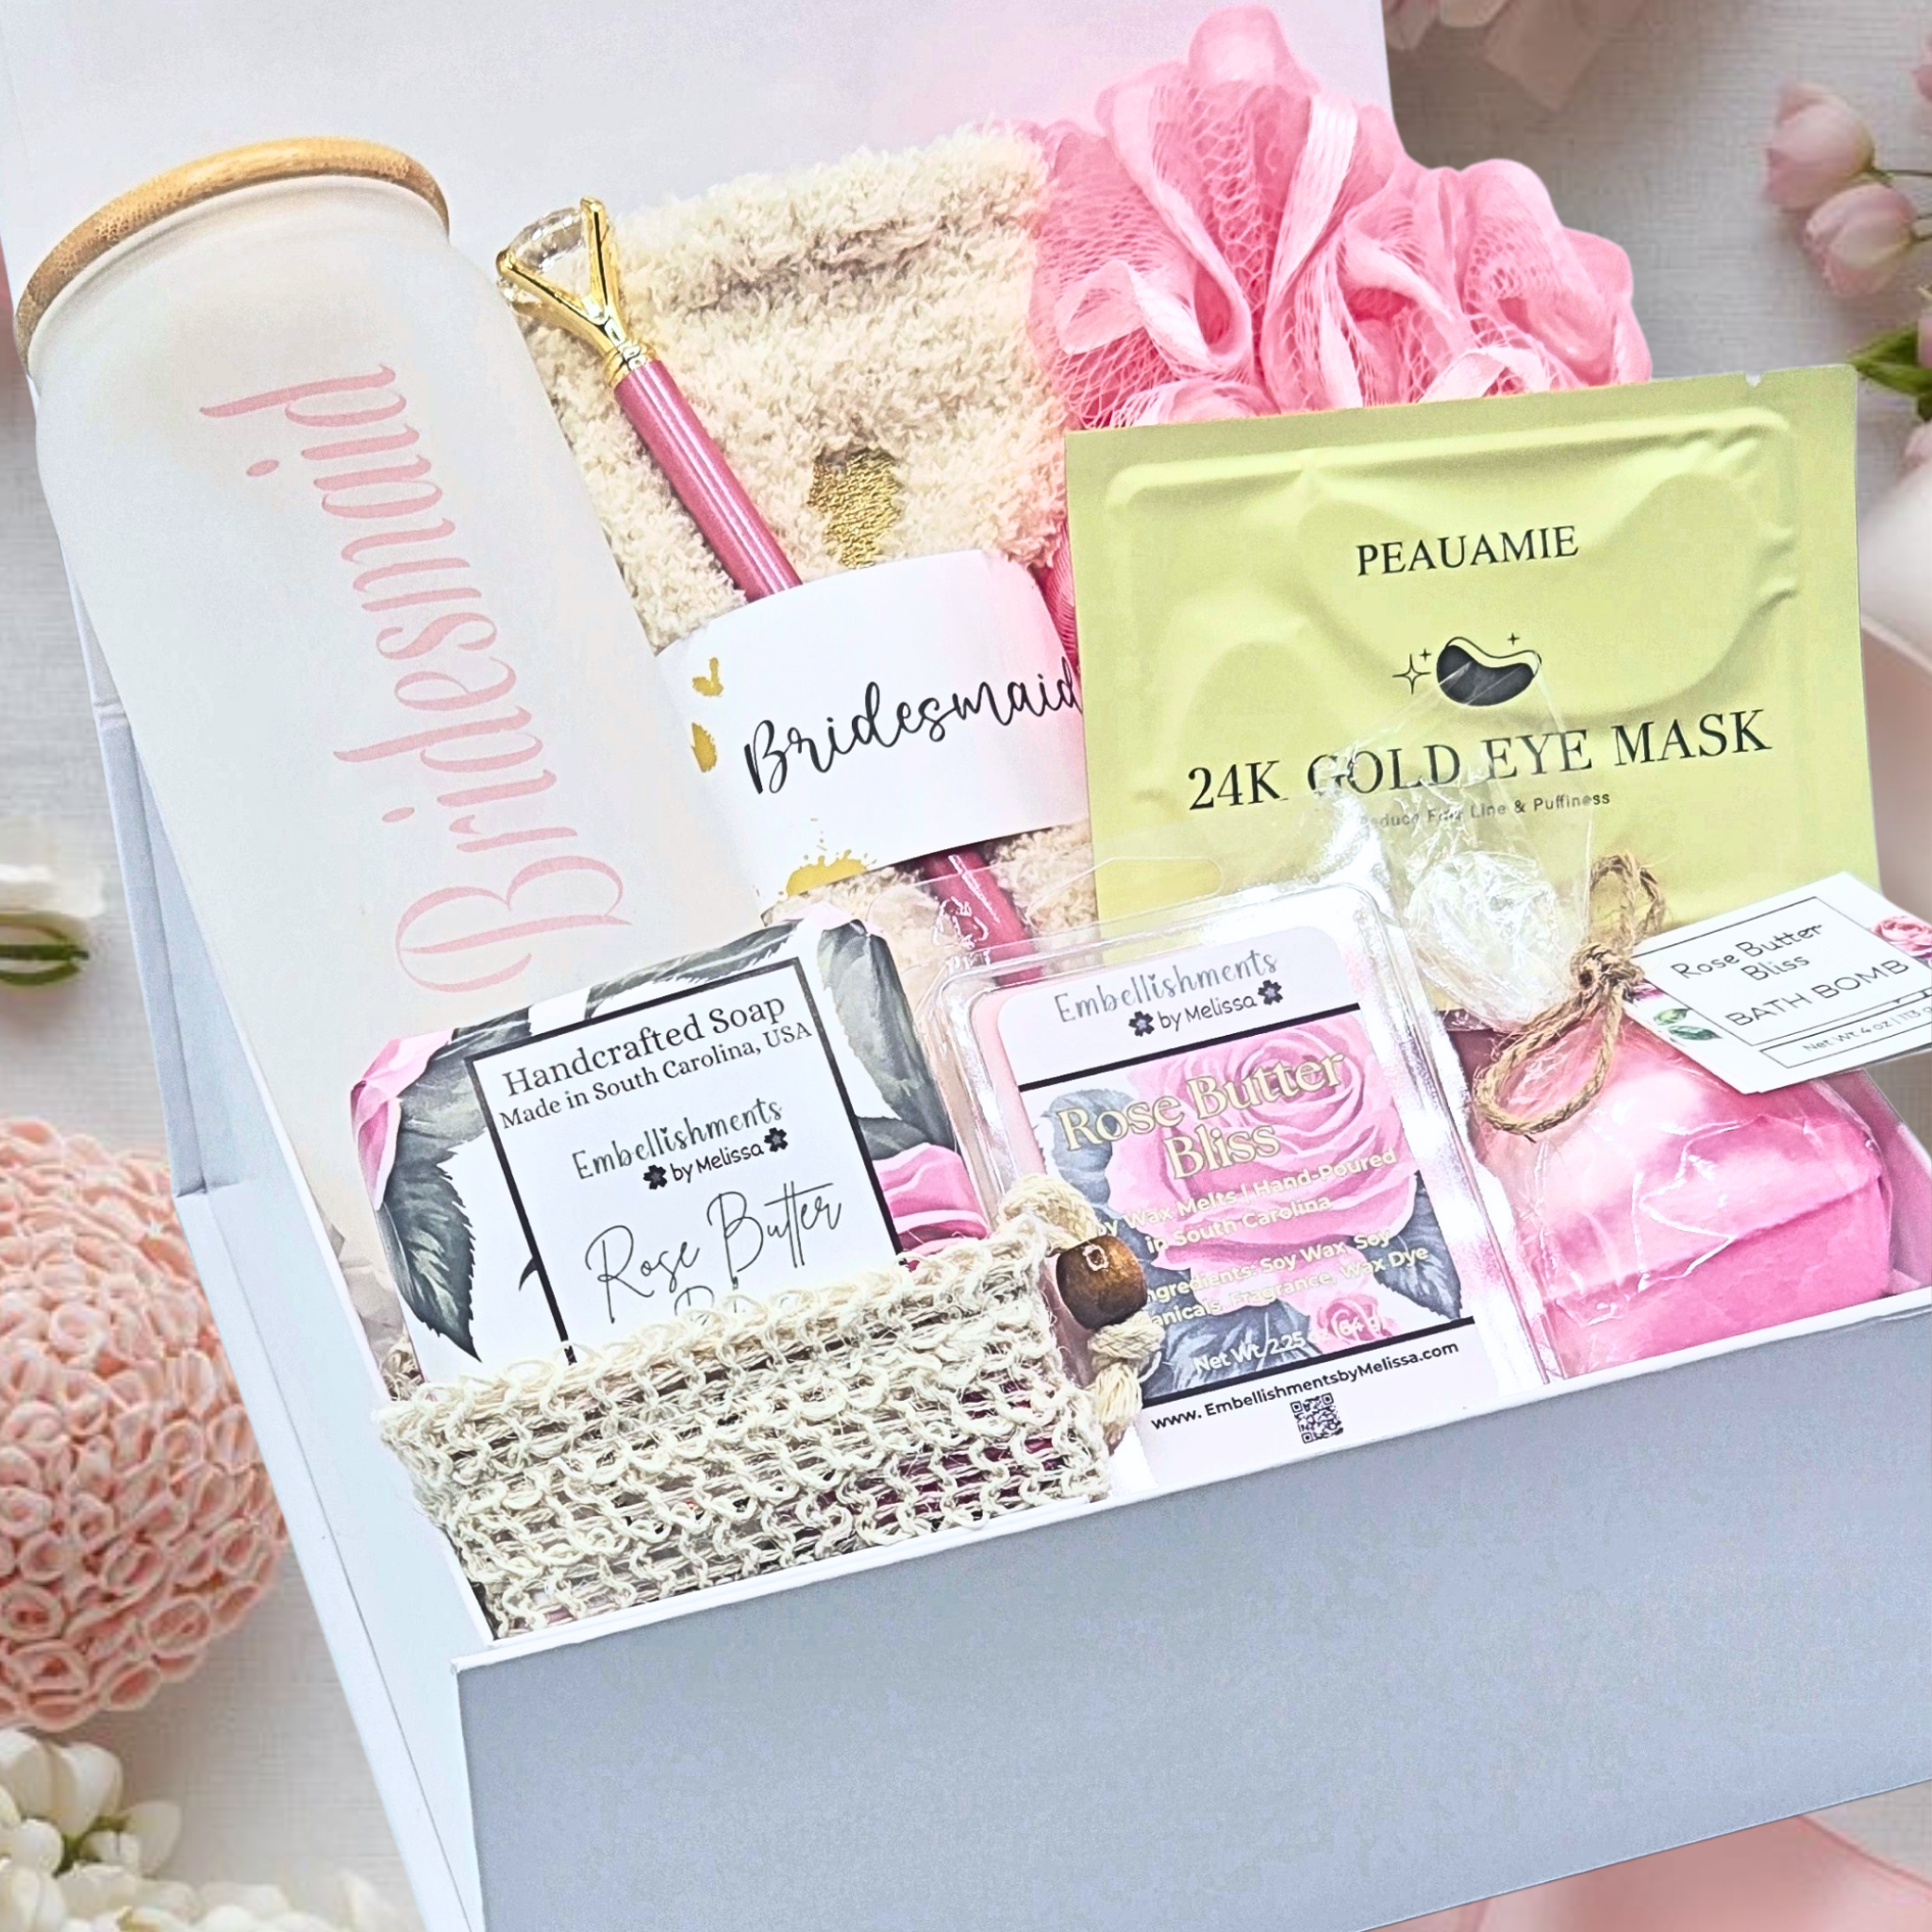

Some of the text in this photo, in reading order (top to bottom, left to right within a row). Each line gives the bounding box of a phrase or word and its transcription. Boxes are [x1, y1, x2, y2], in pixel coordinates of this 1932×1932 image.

[1356, 525, 1579, 576] PEAUAMIE
[199, 363, 632, 992] Bridesmaid
[744, 657, 1082, 794] Bridesmaid
[1189, 708, 1772, 810] 24K GOLD EYE MASK
[1471, 805, 1506, 819] Line
[1514, 800, 1525, 813] &
[1534, 793, 1610, 810] Puffiness
[1055, 949, 1277, 1024] Embellishments
[1670, 924, 1823, 979] Rose Butter
[1740, 955, 1809, 981] Bliss
[1158, 993, 1257, 1031] by Melissa
[1724, 958, 1909, 1026] BATH BOMB
[500, 1022, 812, 1130] Made in South Carolina, USA
[503, 995, 785, 1096] Handcrafted Soap
[572, 1096, 782, 1180] Embellishments
[1057, 1052, 1345, 1151] Rose Butter
[671, 1140, 764, 1183] by Melissa
[1123, 1204, 1174, 1227] Wax
[1175, 1190, 1238, 1219] Melts
[1254, 1148, 1398, 1200] Hand-Poured
[1163, 1124, 1281, 1179] Bliss
[585, 1224, 700, 1323] Rose
[707, 1181, 841, 1289] Butter
[1145, 1193, 1333, 1254] in South Carolina
[1147, 1265, 1257, 1305] ngredients:
[1259, 1254, 1296, 1277] Soy
[1353, 1229, 1391, 1250] Soy
[1229, 1272, 1336, 1309] Fragrance,
[1340, 1257, 1386, 1280] Wax
[1389, 1245, 1429, 1270] Dye
[1151, 1341, 1459, 1430] www. EmbellishmentsbyMelissa.com
[1193, 1352, 1231, 1374] Net
[1270, 1331, 1307, 1355] 2.25
